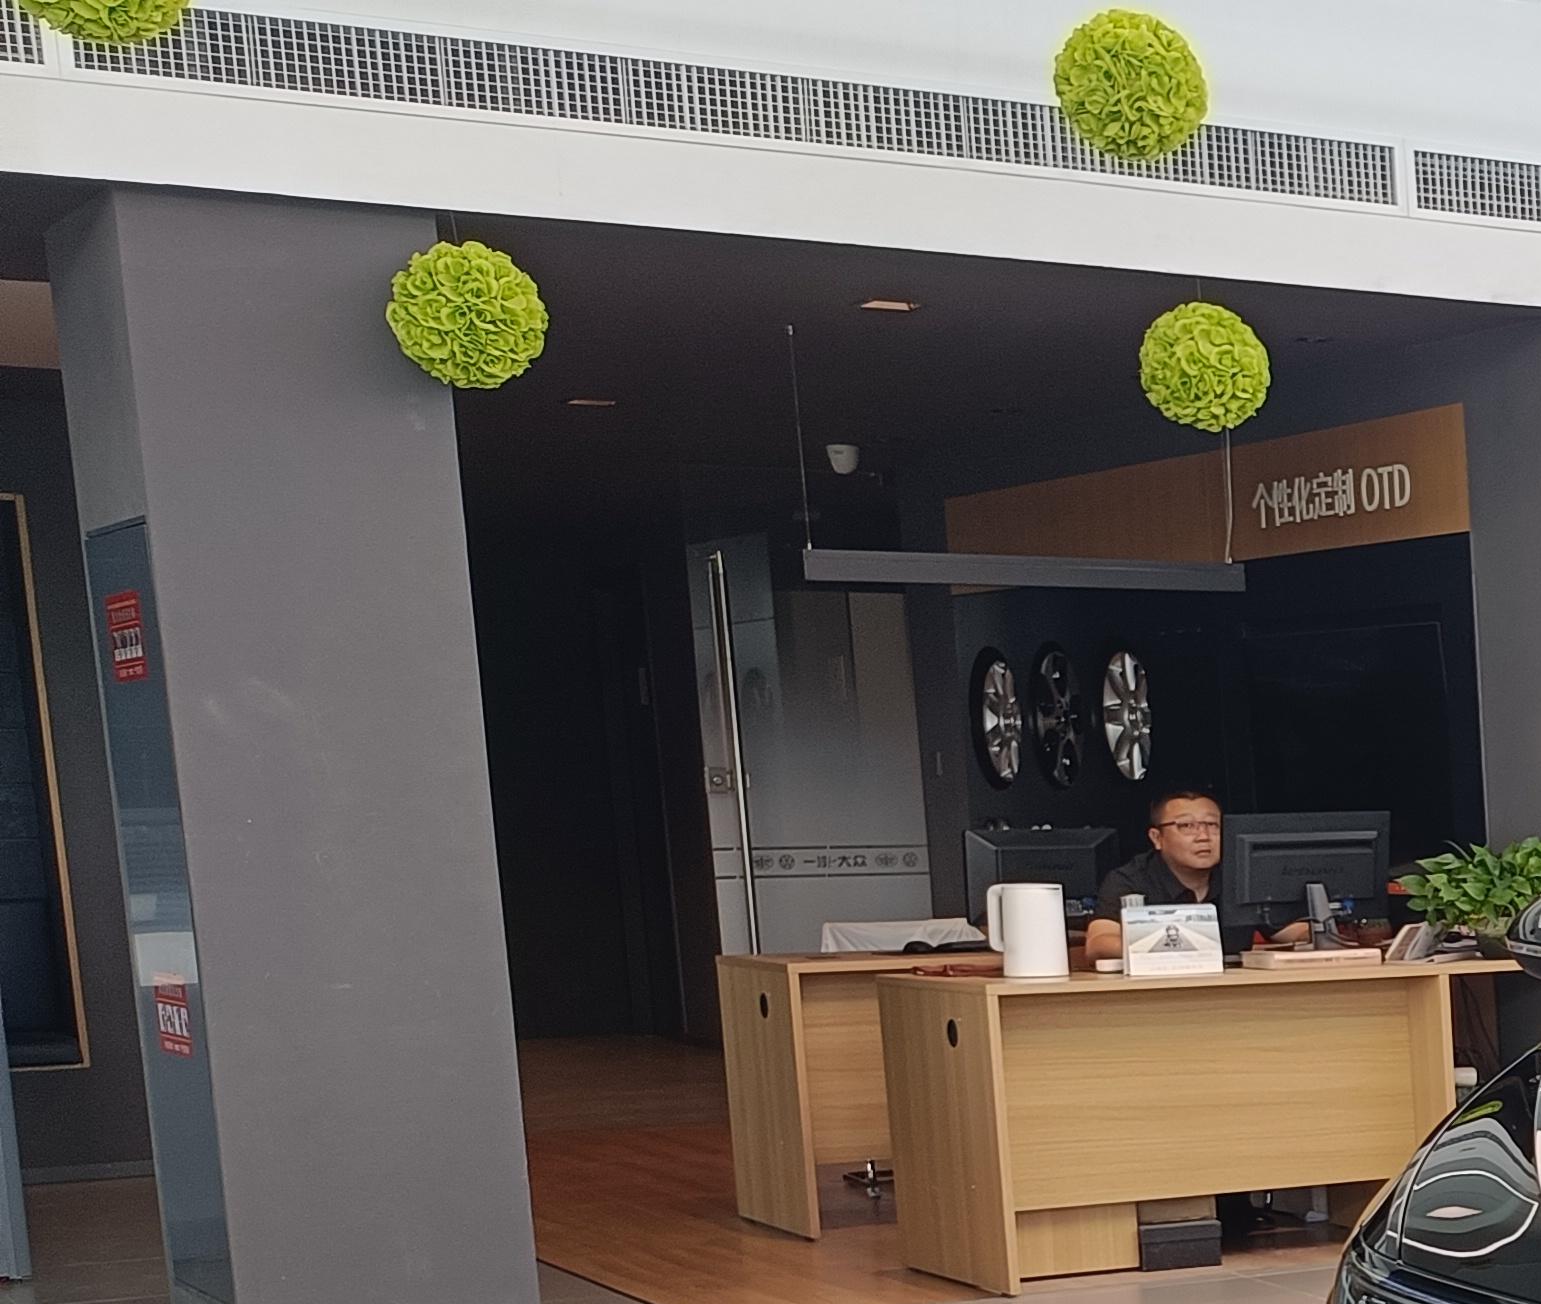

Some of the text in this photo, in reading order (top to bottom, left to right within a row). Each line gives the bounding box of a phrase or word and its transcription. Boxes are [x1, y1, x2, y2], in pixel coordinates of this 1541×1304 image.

[1252, 464, 1411, 528] 个性化定制 OTD
